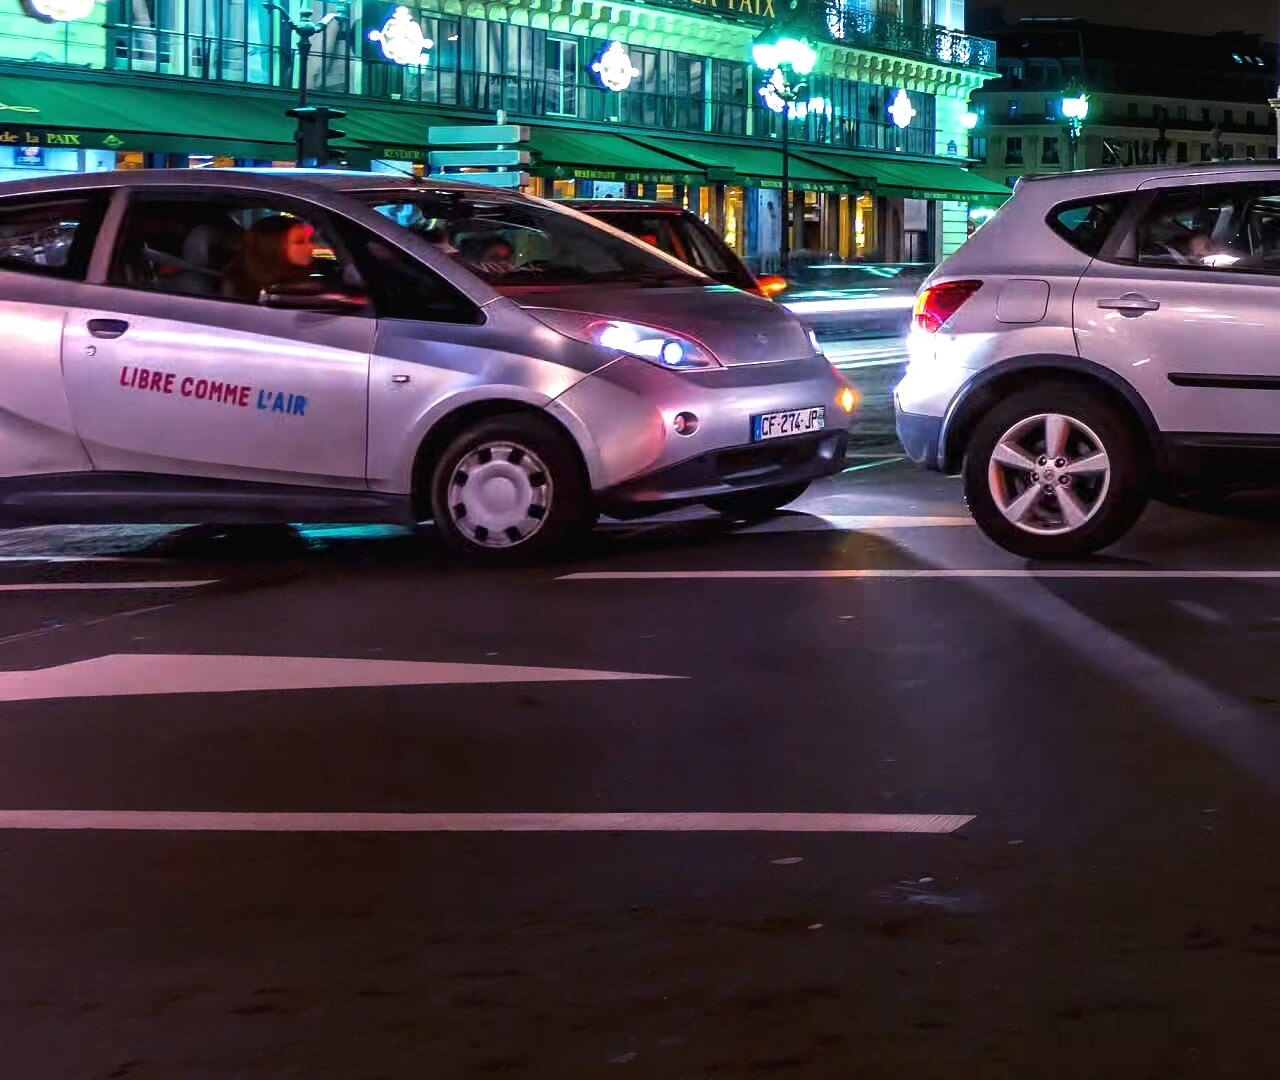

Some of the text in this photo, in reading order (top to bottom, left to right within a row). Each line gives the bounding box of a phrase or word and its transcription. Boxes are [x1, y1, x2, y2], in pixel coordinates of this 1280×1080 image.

[25, 131, 39, 143] la
[46, 133, 81, 145] PAIX
[120, 366, 308, 417] LIBRE COMME L'AIR
[762, 410, 818, 436] CF-274-JP
